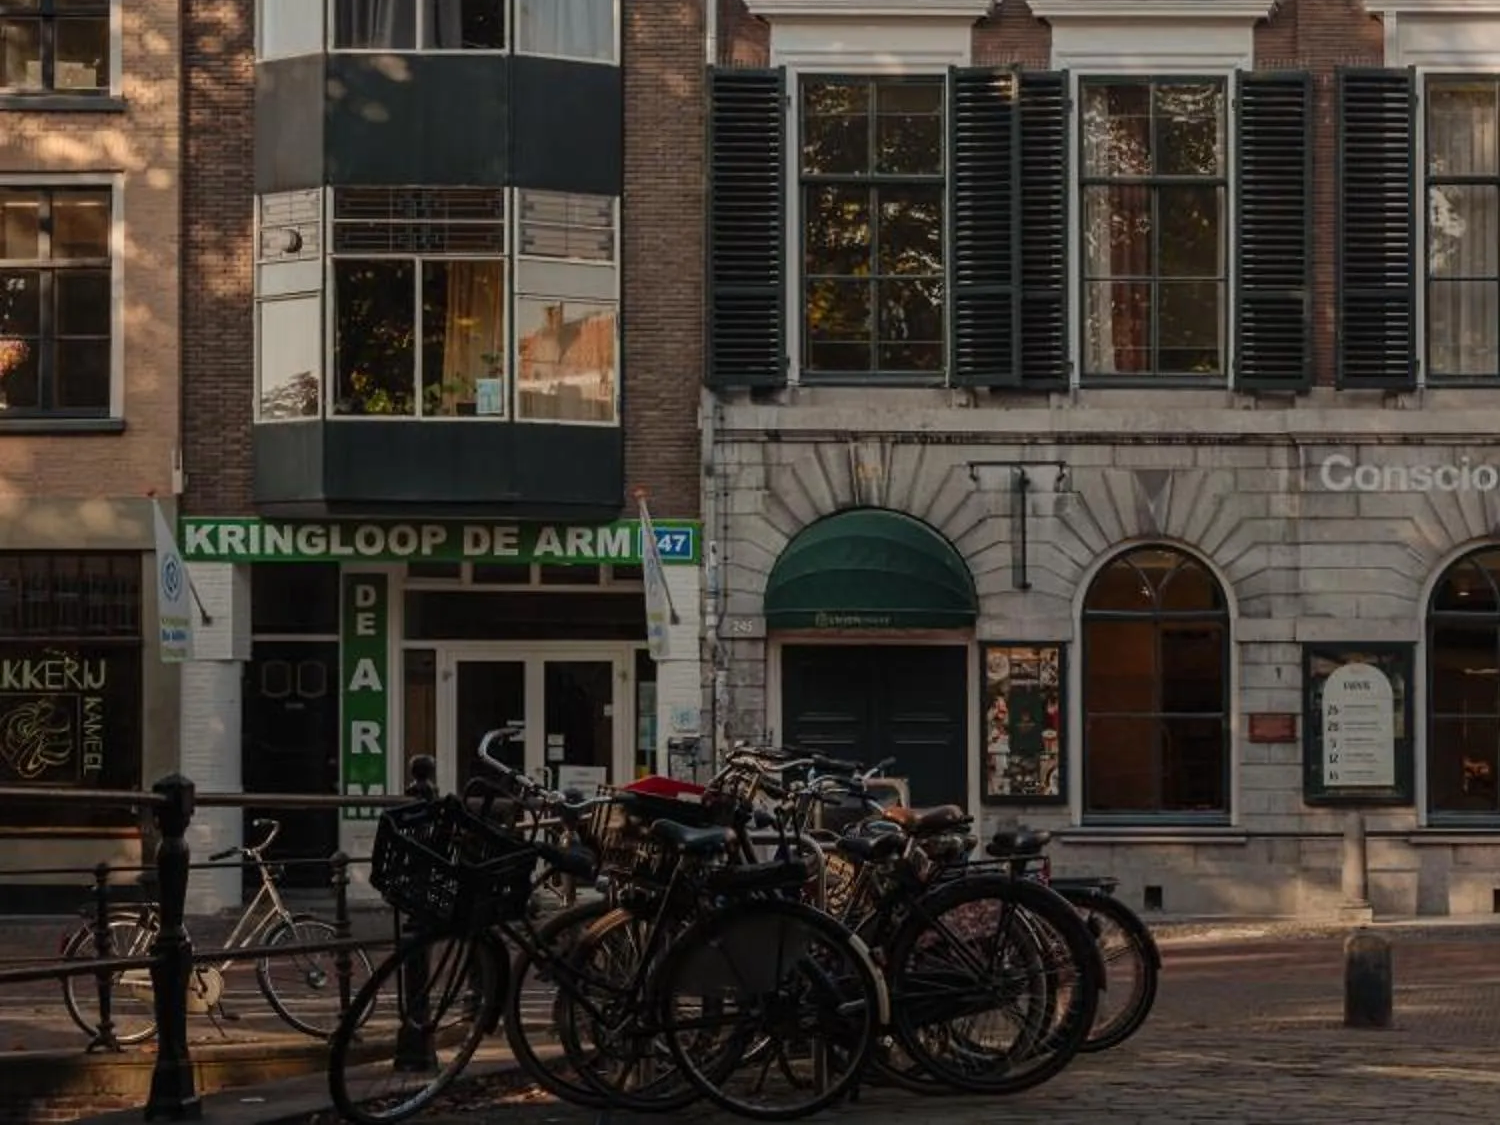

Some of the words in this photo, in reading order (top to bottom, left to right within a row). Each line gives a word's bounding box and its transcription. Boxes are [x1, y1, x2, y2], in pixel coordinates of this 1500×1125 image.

[185, 524, 447, 556] KRINGLOOP
[464, 526, 519, 556] DE
[534, 526, 631, 557] ARM
[655, 534, 687, 552] 47
[355, 584, 376, 636] DE
[0, 659, 106, 690] KKERIJ
